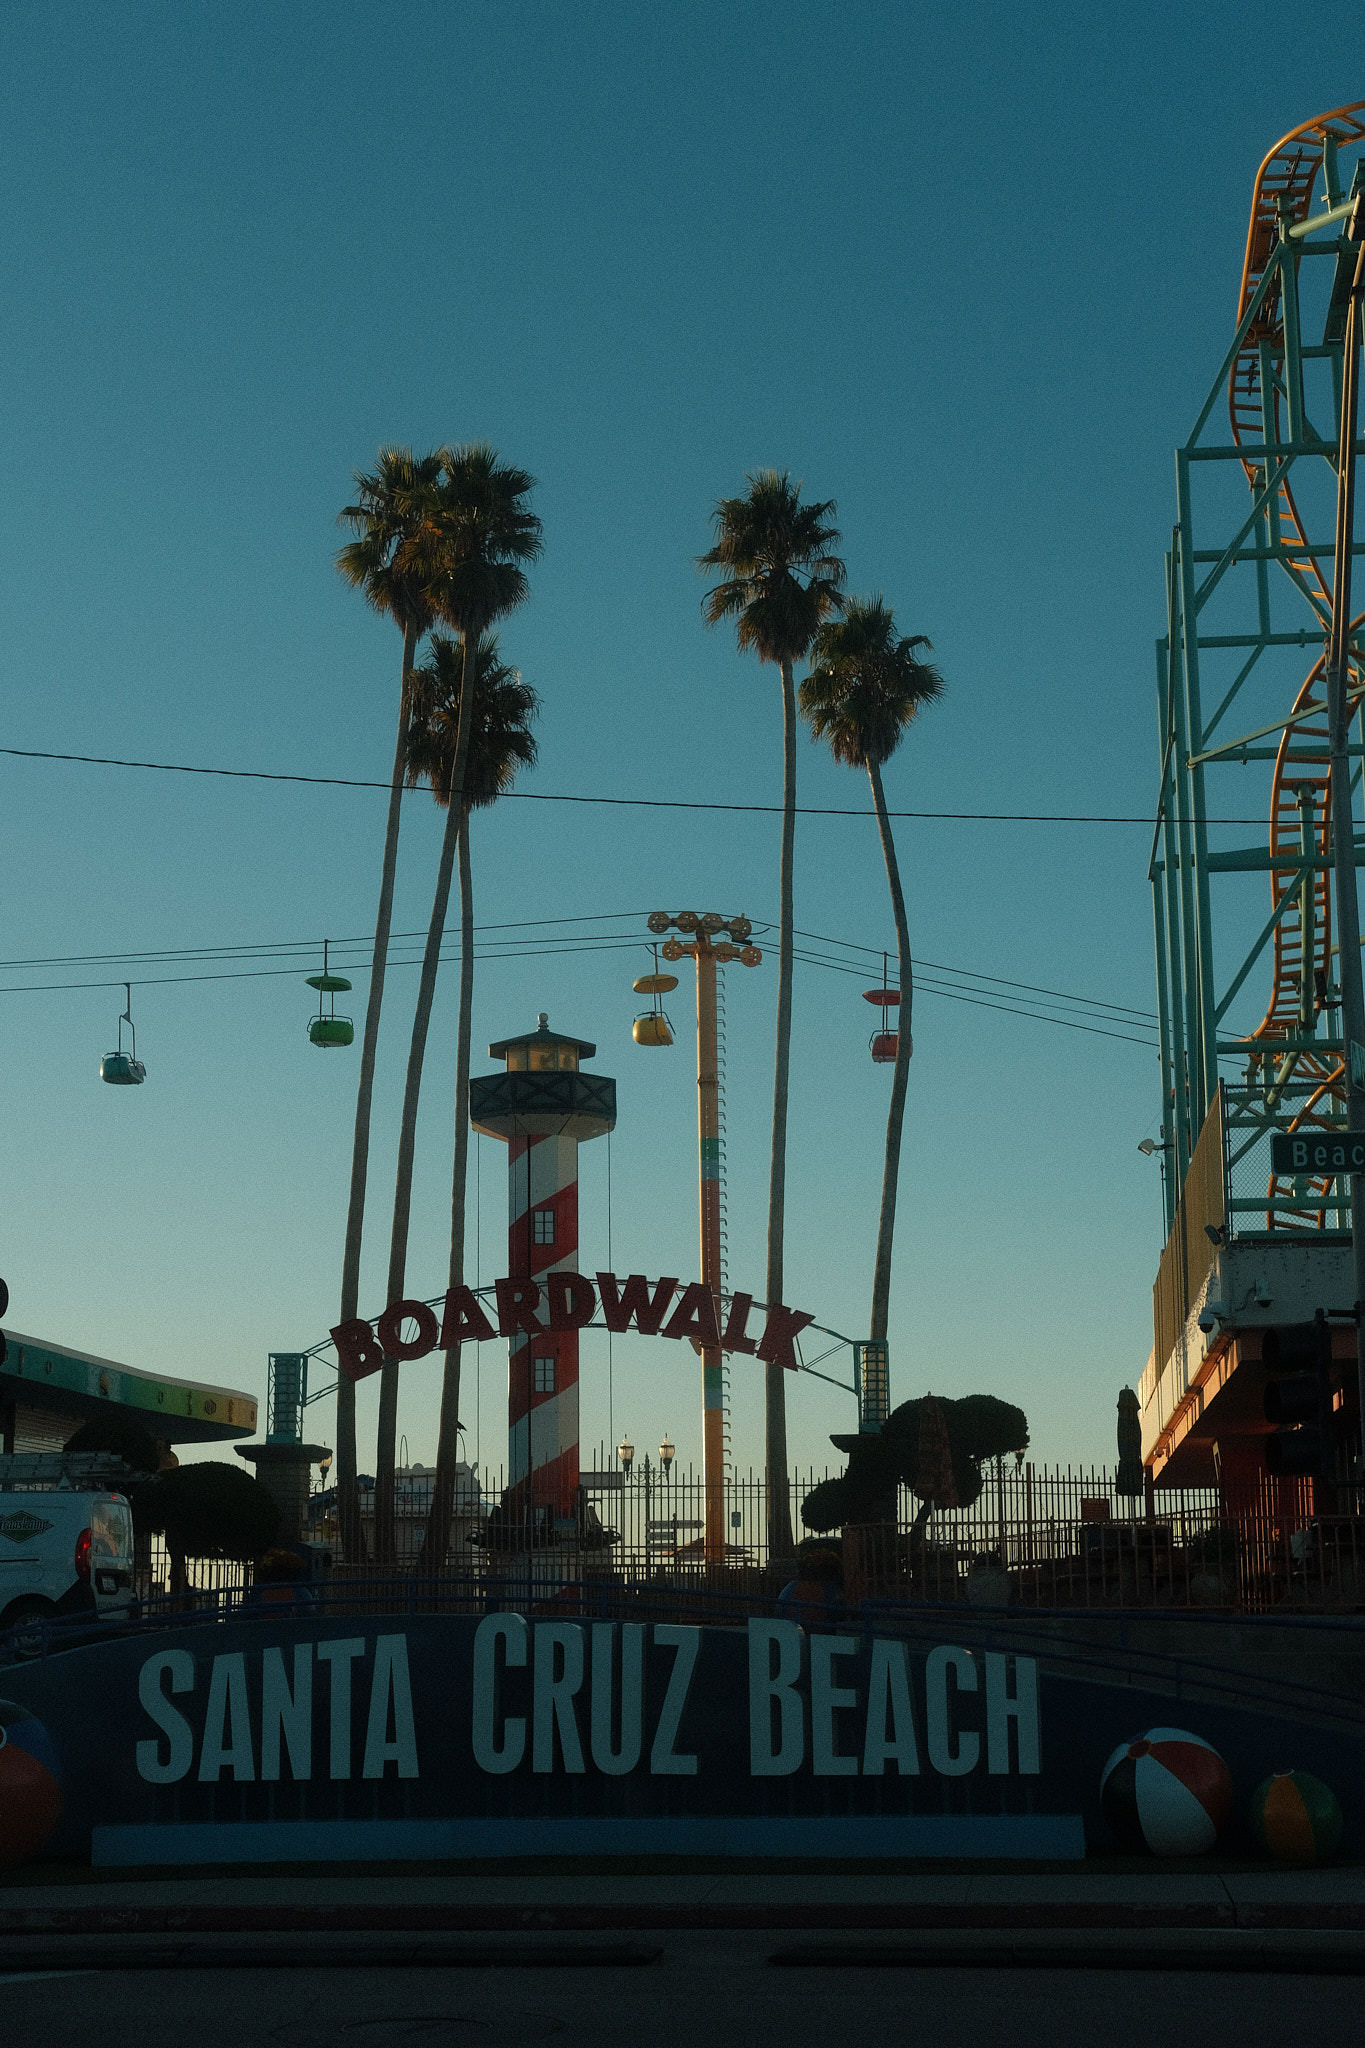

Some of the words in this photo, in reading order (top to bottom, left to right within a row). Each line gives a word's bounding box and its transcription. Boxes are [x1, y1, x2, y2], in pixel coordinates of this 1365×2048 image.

[329, 1271, 815, 1382] BOARDWALK
[136, 1633, 420, 1784] SANTA
[472, 1612, 703, 1776] CRUZ
[748, 1616, 1041, 1777] BEACH
